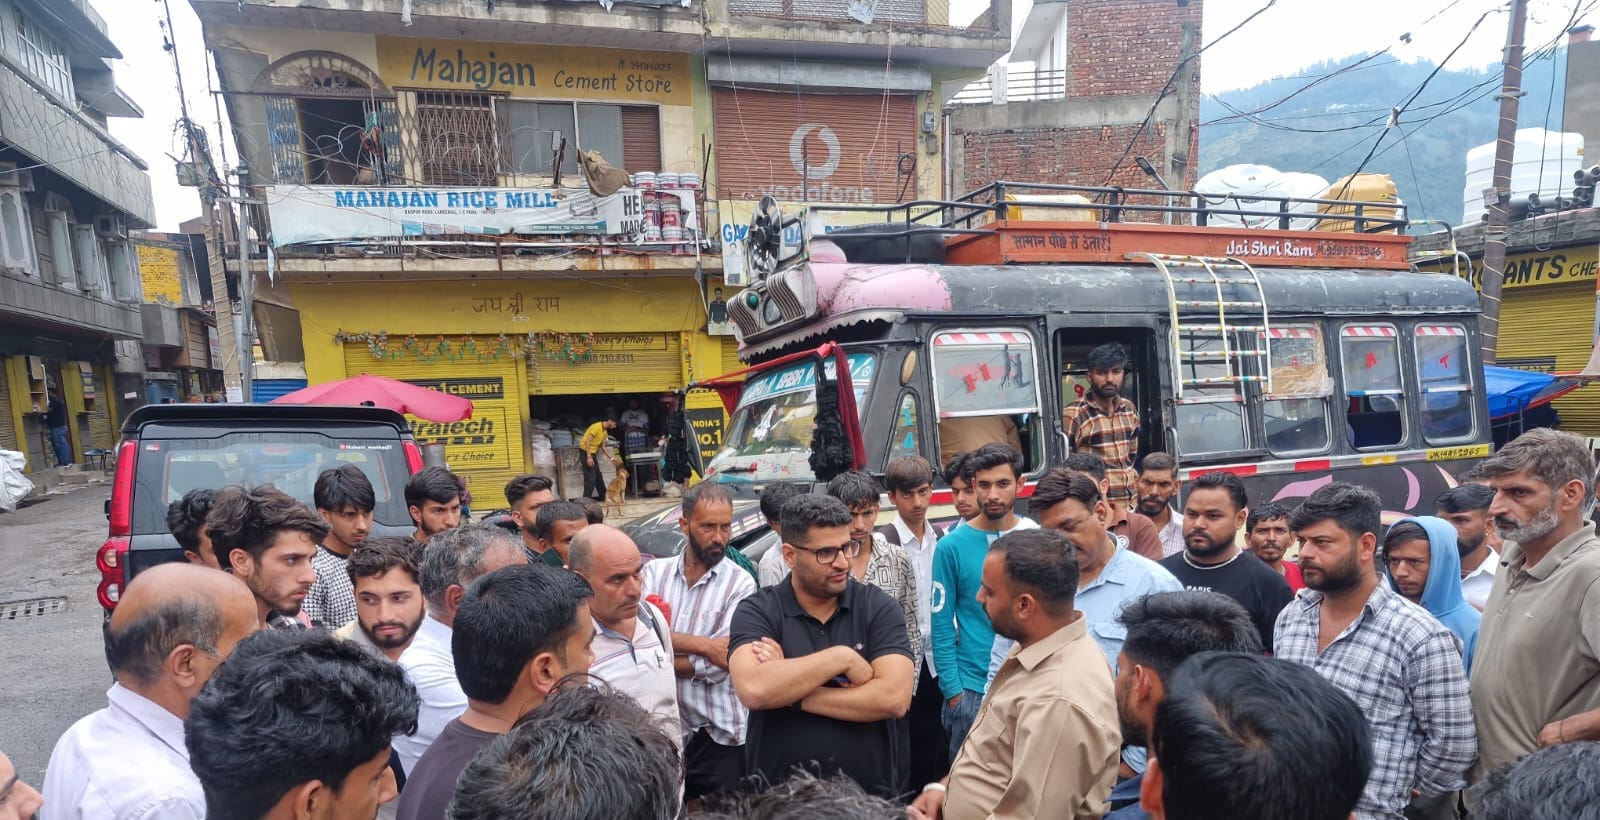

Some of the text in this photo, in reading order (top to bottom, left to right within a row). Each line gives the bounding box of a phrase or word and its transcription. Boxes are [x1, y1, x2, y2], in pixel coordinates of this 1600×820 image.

[410, 47, 536, 90] Mahajan
[553, 70, 672, 93] Cement Store
[335, 191, 439, 208] MAHAJAN
[447, 192, 498, 208] RICE
[505, 192, 558, 209] MILL
[1012, 233, 1045, 249] सामान
[1226, 240, 1249, 257] Jai
[1251, 240, 1282, 257] Shri
[1284, 241, 1313, 258] Ram
[472, 296, 502, 315] जय
[534, 296, 560, 313] राम
[449, 383, 500, 395] CEMENT
[462, 450, 495, 461] Choice
